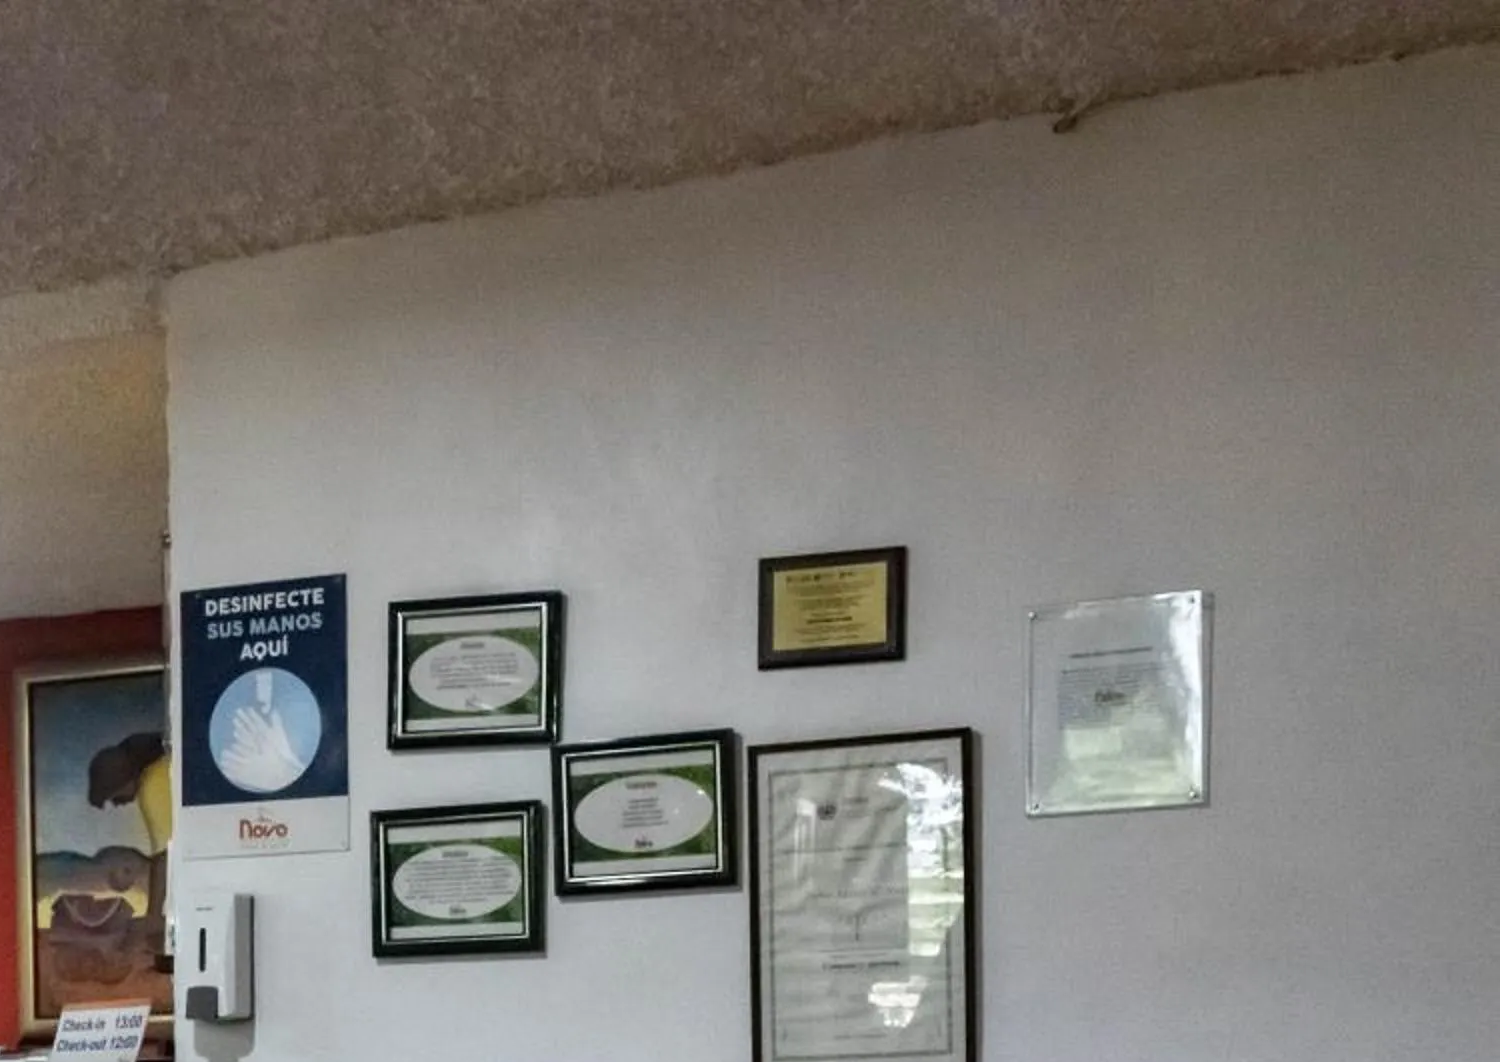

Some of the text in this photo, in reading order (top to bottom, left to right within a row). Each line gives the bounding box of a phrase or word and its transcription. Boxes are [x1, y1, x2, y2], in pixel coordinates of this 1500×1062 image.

[205, 587, 325, 616] DESINFECTE
[207, 611, 323, 639] SUS MANOS
